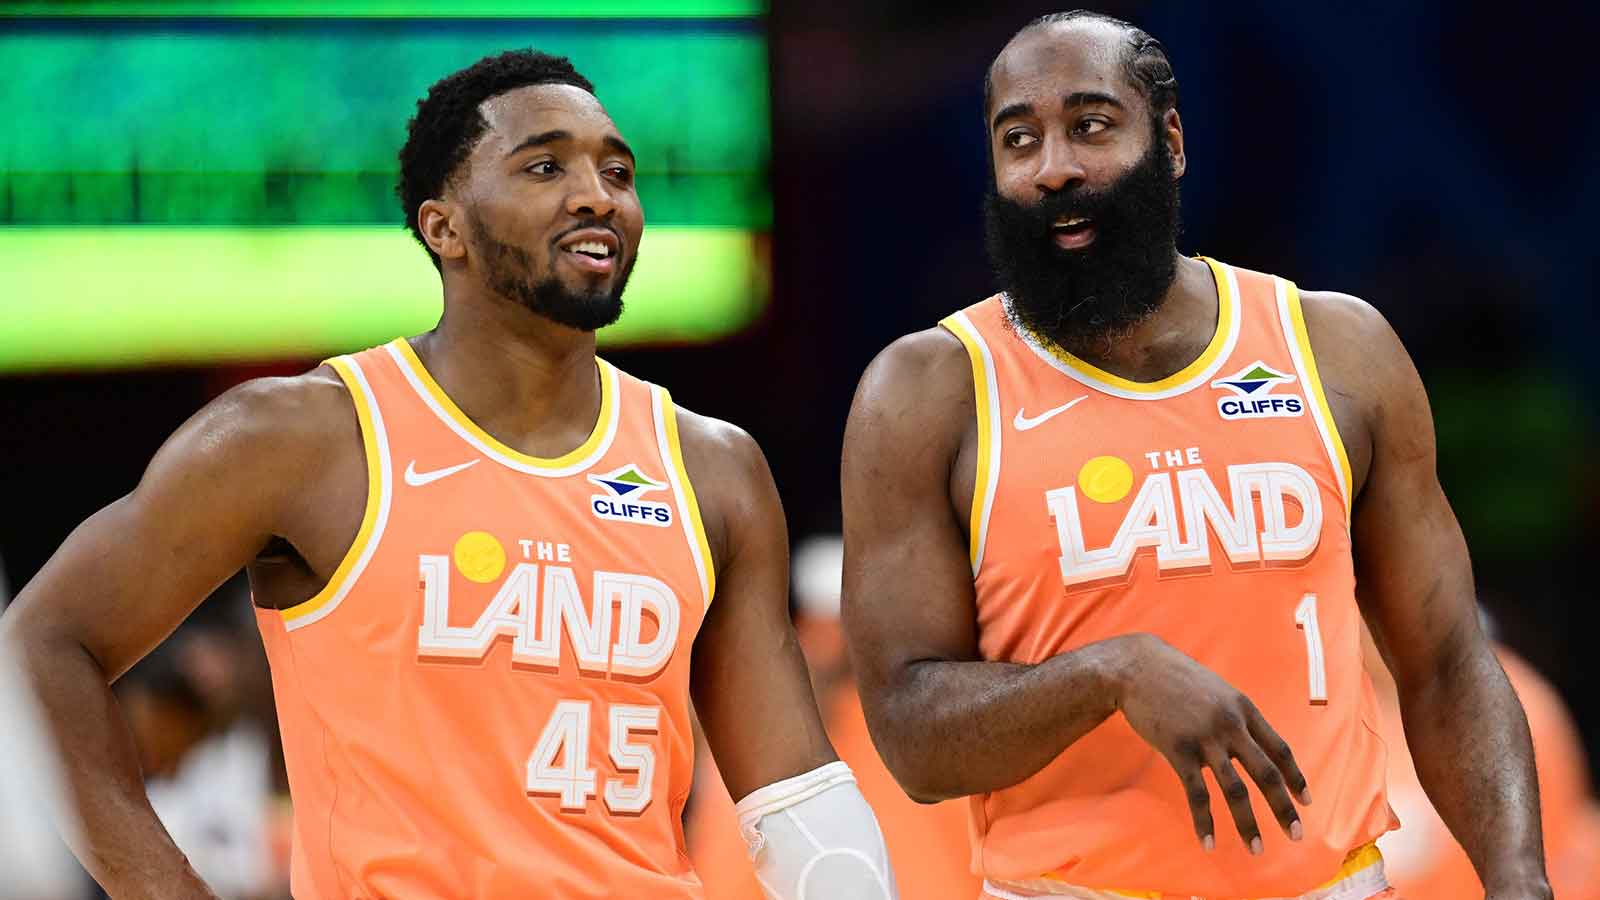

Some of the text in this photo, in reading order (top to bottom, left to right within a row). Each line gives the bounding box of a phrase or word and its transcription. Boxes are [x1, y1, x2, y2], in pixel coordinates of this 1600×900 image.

[1221, 399, 1302, 416] CLIFFS
[1145, 447, 1202, 469] THE
[593, 499, 671, 523] CLIFFS
[1046, 462, 1323, 592] LAND
[518, 539, 572, 562] THE
[417, 554, 681, 684] LAND
[1295, 593, 1329, 706] 1
[526, 701, 661, 817] 45
